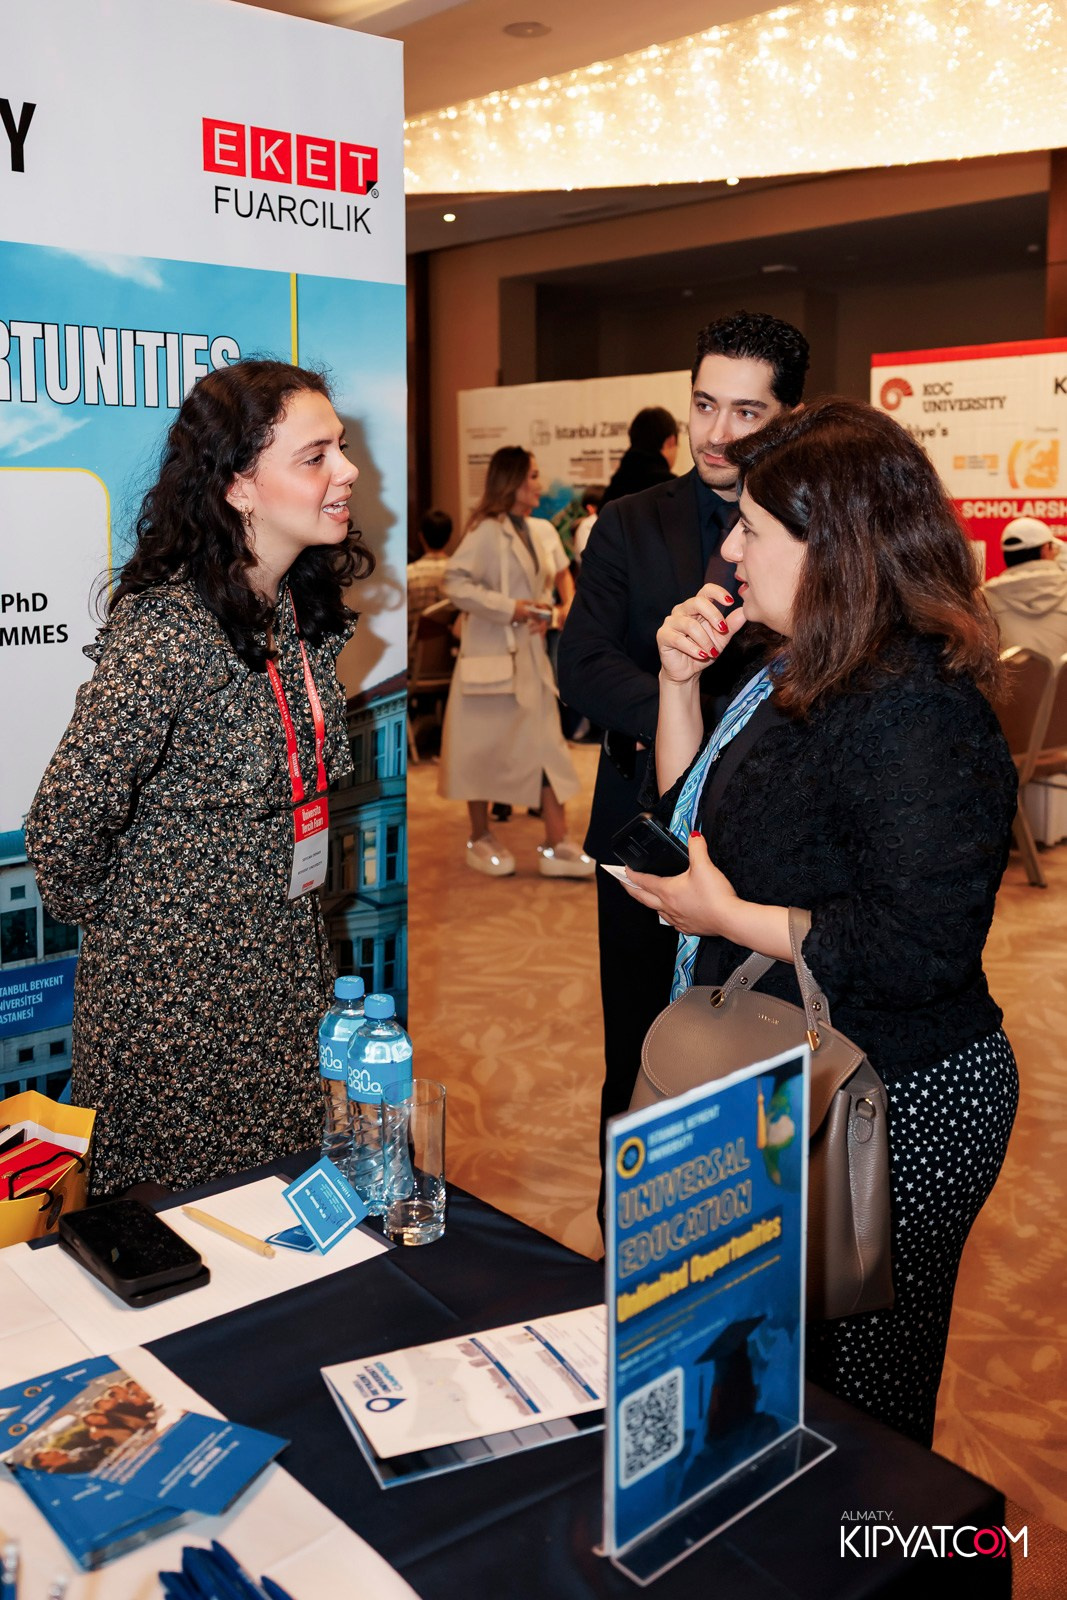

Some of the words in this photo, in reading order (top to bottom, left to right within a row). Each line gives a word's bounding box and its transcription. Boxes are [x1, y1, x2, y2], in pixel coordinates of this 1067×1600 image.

[213, 128, 372, 188] EKET
[213, 186, 372, 234] FUARCILIK
[0, 319, 241, 408] TUNITIE
[922, 396, 1007, 414] UNIVERSITY
[1, 592, 48, 613] PhD
[0, 624, 69, 647] MMES
[30, 975, 64, 991] BEYKENT
[617, 1137, 751, 1229] UNIVERSAL
[617, 1179, 752, 1279] EDUCATION
